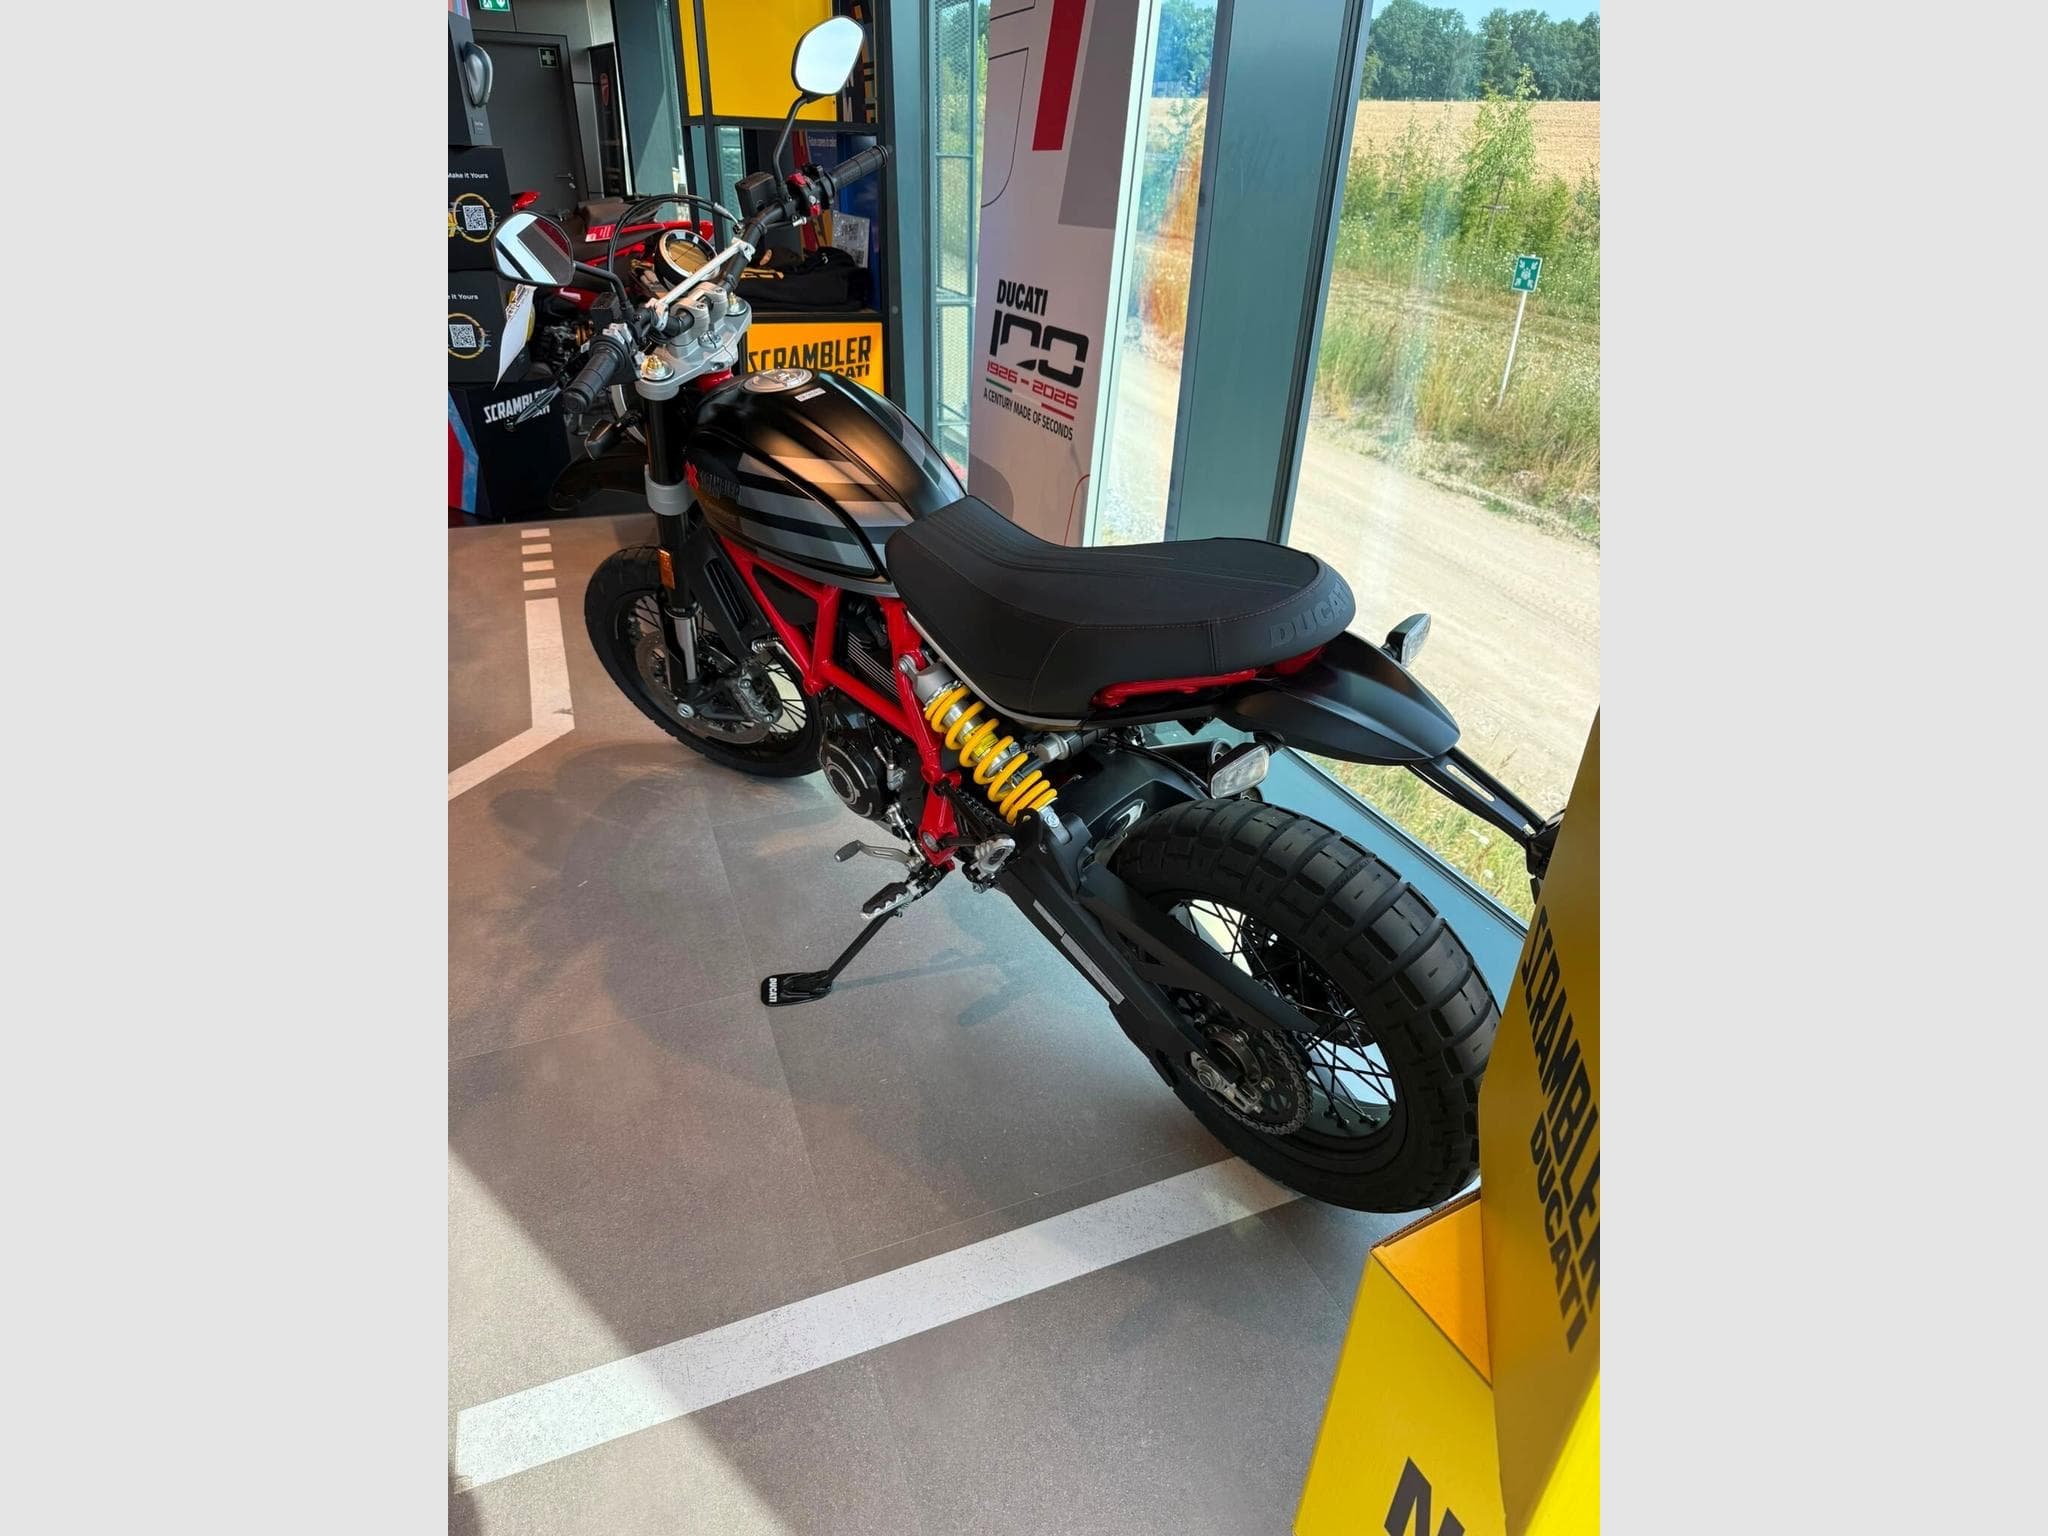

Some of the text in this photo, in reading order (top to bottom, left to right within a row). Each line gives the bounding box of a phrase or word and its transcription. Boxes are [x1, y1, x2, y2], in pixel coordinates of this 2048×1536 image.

[996, 279, 1048, 316] DUCATI
[748, 335, 871, 373] SCRAMBLER
[833, 363, 870, 378] CATI
[987, 360, 1018, 384] 1926
[1032, 380, 1079, 409] 2026
[483, 388, 549, 424] SCRAMB
[983, 387, 1073, 441] A CENTURY MADE OF SECONDS
[769, 978, 777, 1002] DUCATI
[1530, 1111, 1587, 1353] DUCATI
